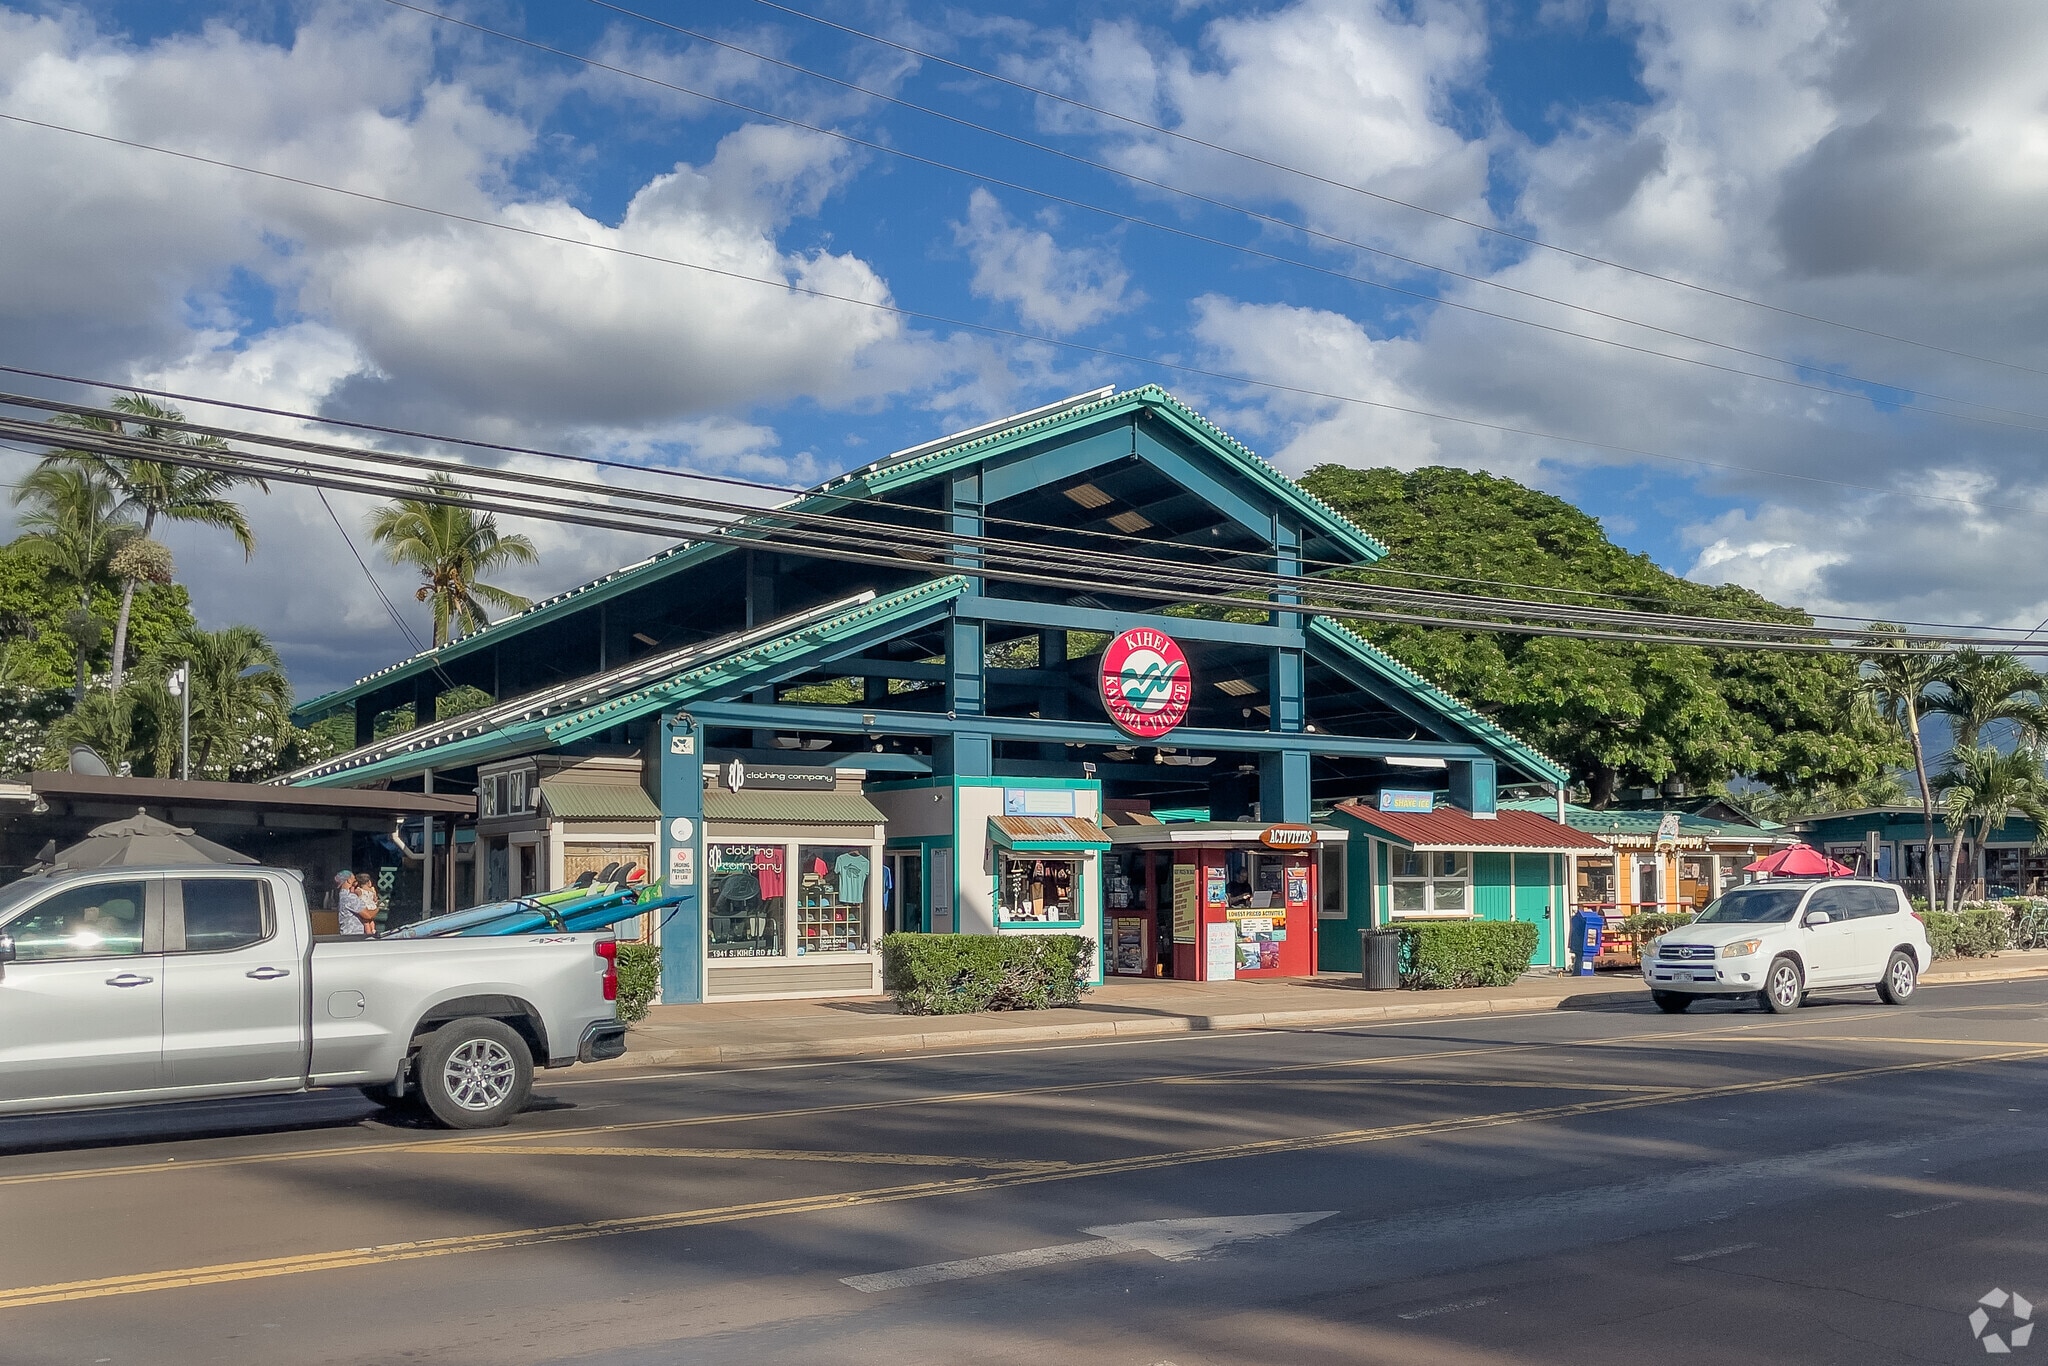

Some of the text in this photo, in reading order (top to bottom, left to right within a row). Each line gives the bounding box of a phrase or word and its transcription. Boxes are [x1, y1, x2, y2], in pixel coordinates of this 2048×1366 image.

[1124, 631, 1171, 655] KIHEI
[1105, 675, 1188, 732] KALAMA VILLAGE
[746, 771, 786, 781] clothing
[787, 773, 833, 783] company
[1394, 799, 1430, 808] SHAVE ICE
[1269, 829, 1313, 844] ACTIVITIES
[725, 845, 774, 858] clothing
[721, 861, 783, 873] company
[713, 950, 728, 958] 1941
[729, 949, 736, 957] S.
[736, 949, 755, 957] KIHEI
